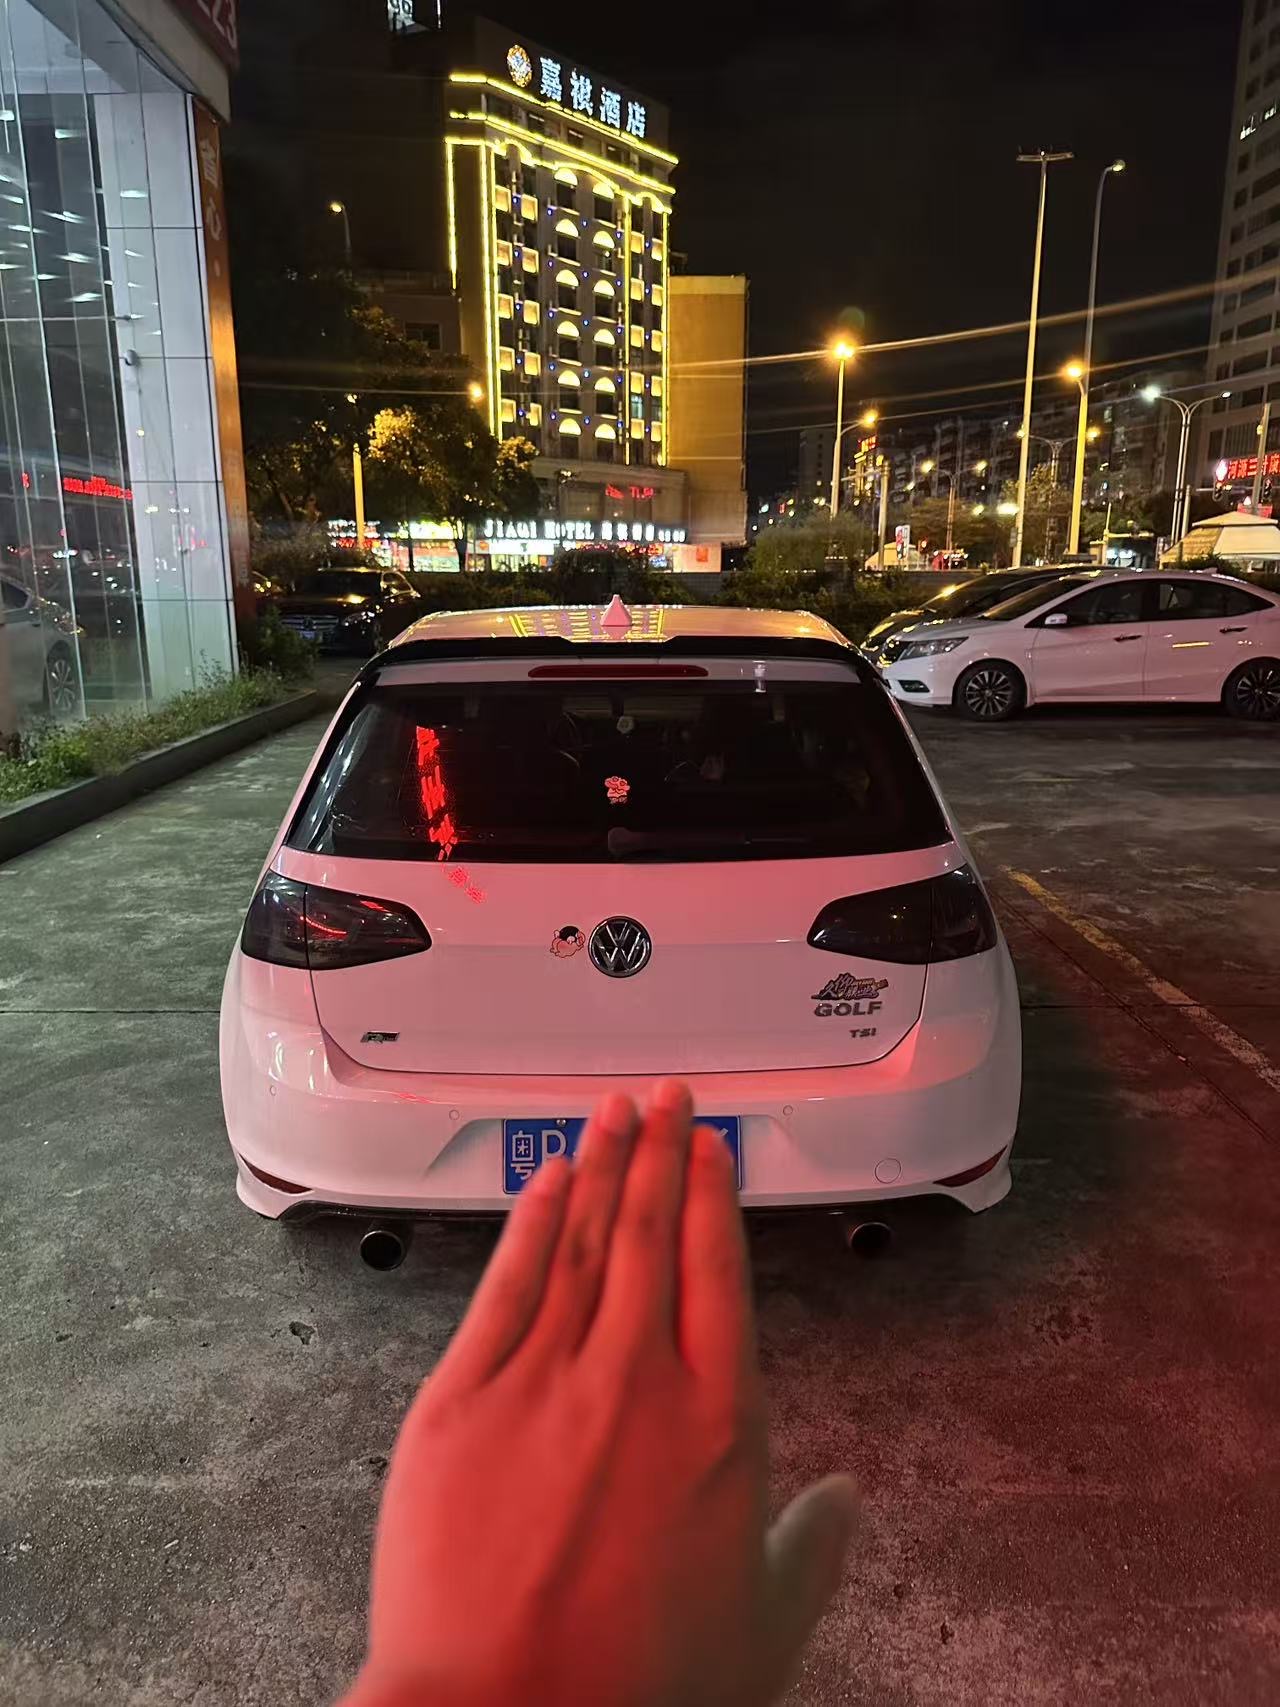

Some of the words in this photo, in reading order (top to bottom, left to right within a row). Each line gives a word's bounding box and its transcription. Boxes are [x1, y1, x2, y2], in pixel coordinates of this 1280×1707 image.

[544, 520, 595, 541] HOTEL
[814, 1001, 883, 1017] GOLF
[849, 1027, 877, 1038] TSI
